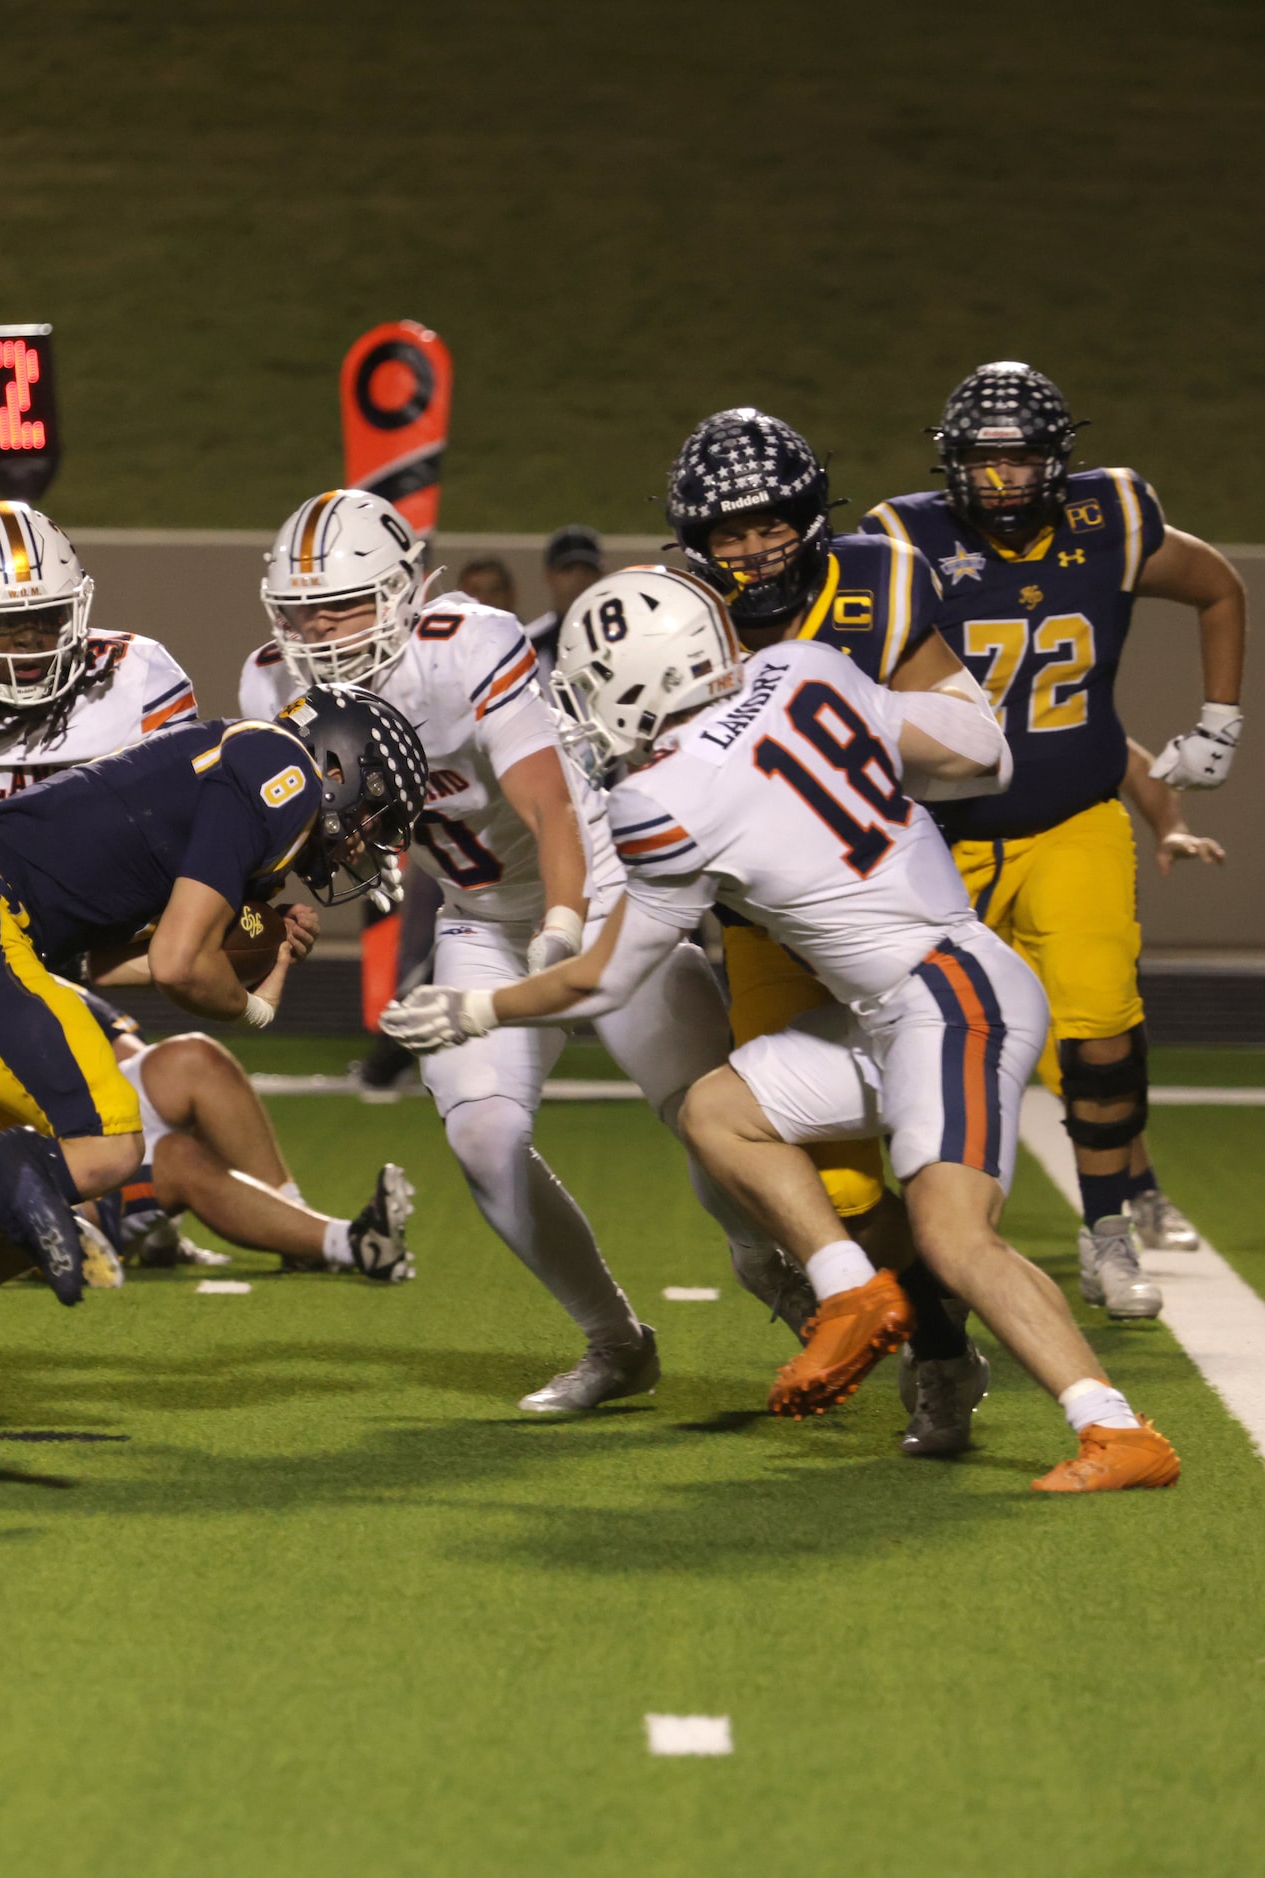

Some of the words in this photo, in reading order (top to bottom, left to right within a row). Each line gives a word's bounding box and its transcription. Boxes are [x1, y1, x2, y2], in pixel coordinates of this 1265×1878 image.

[720, 490, 770, 512] Riddell
[1068, 503, 1103, 531] PC
[583, 598, 629, 653] 18
[835, 596, 872, 625] C
[963, 613, 1096, 734] 72
[701, 662, 790, 750] LANDRY
[259, 765, 306, 809] 8
[752, 679, 914, 881] 18
